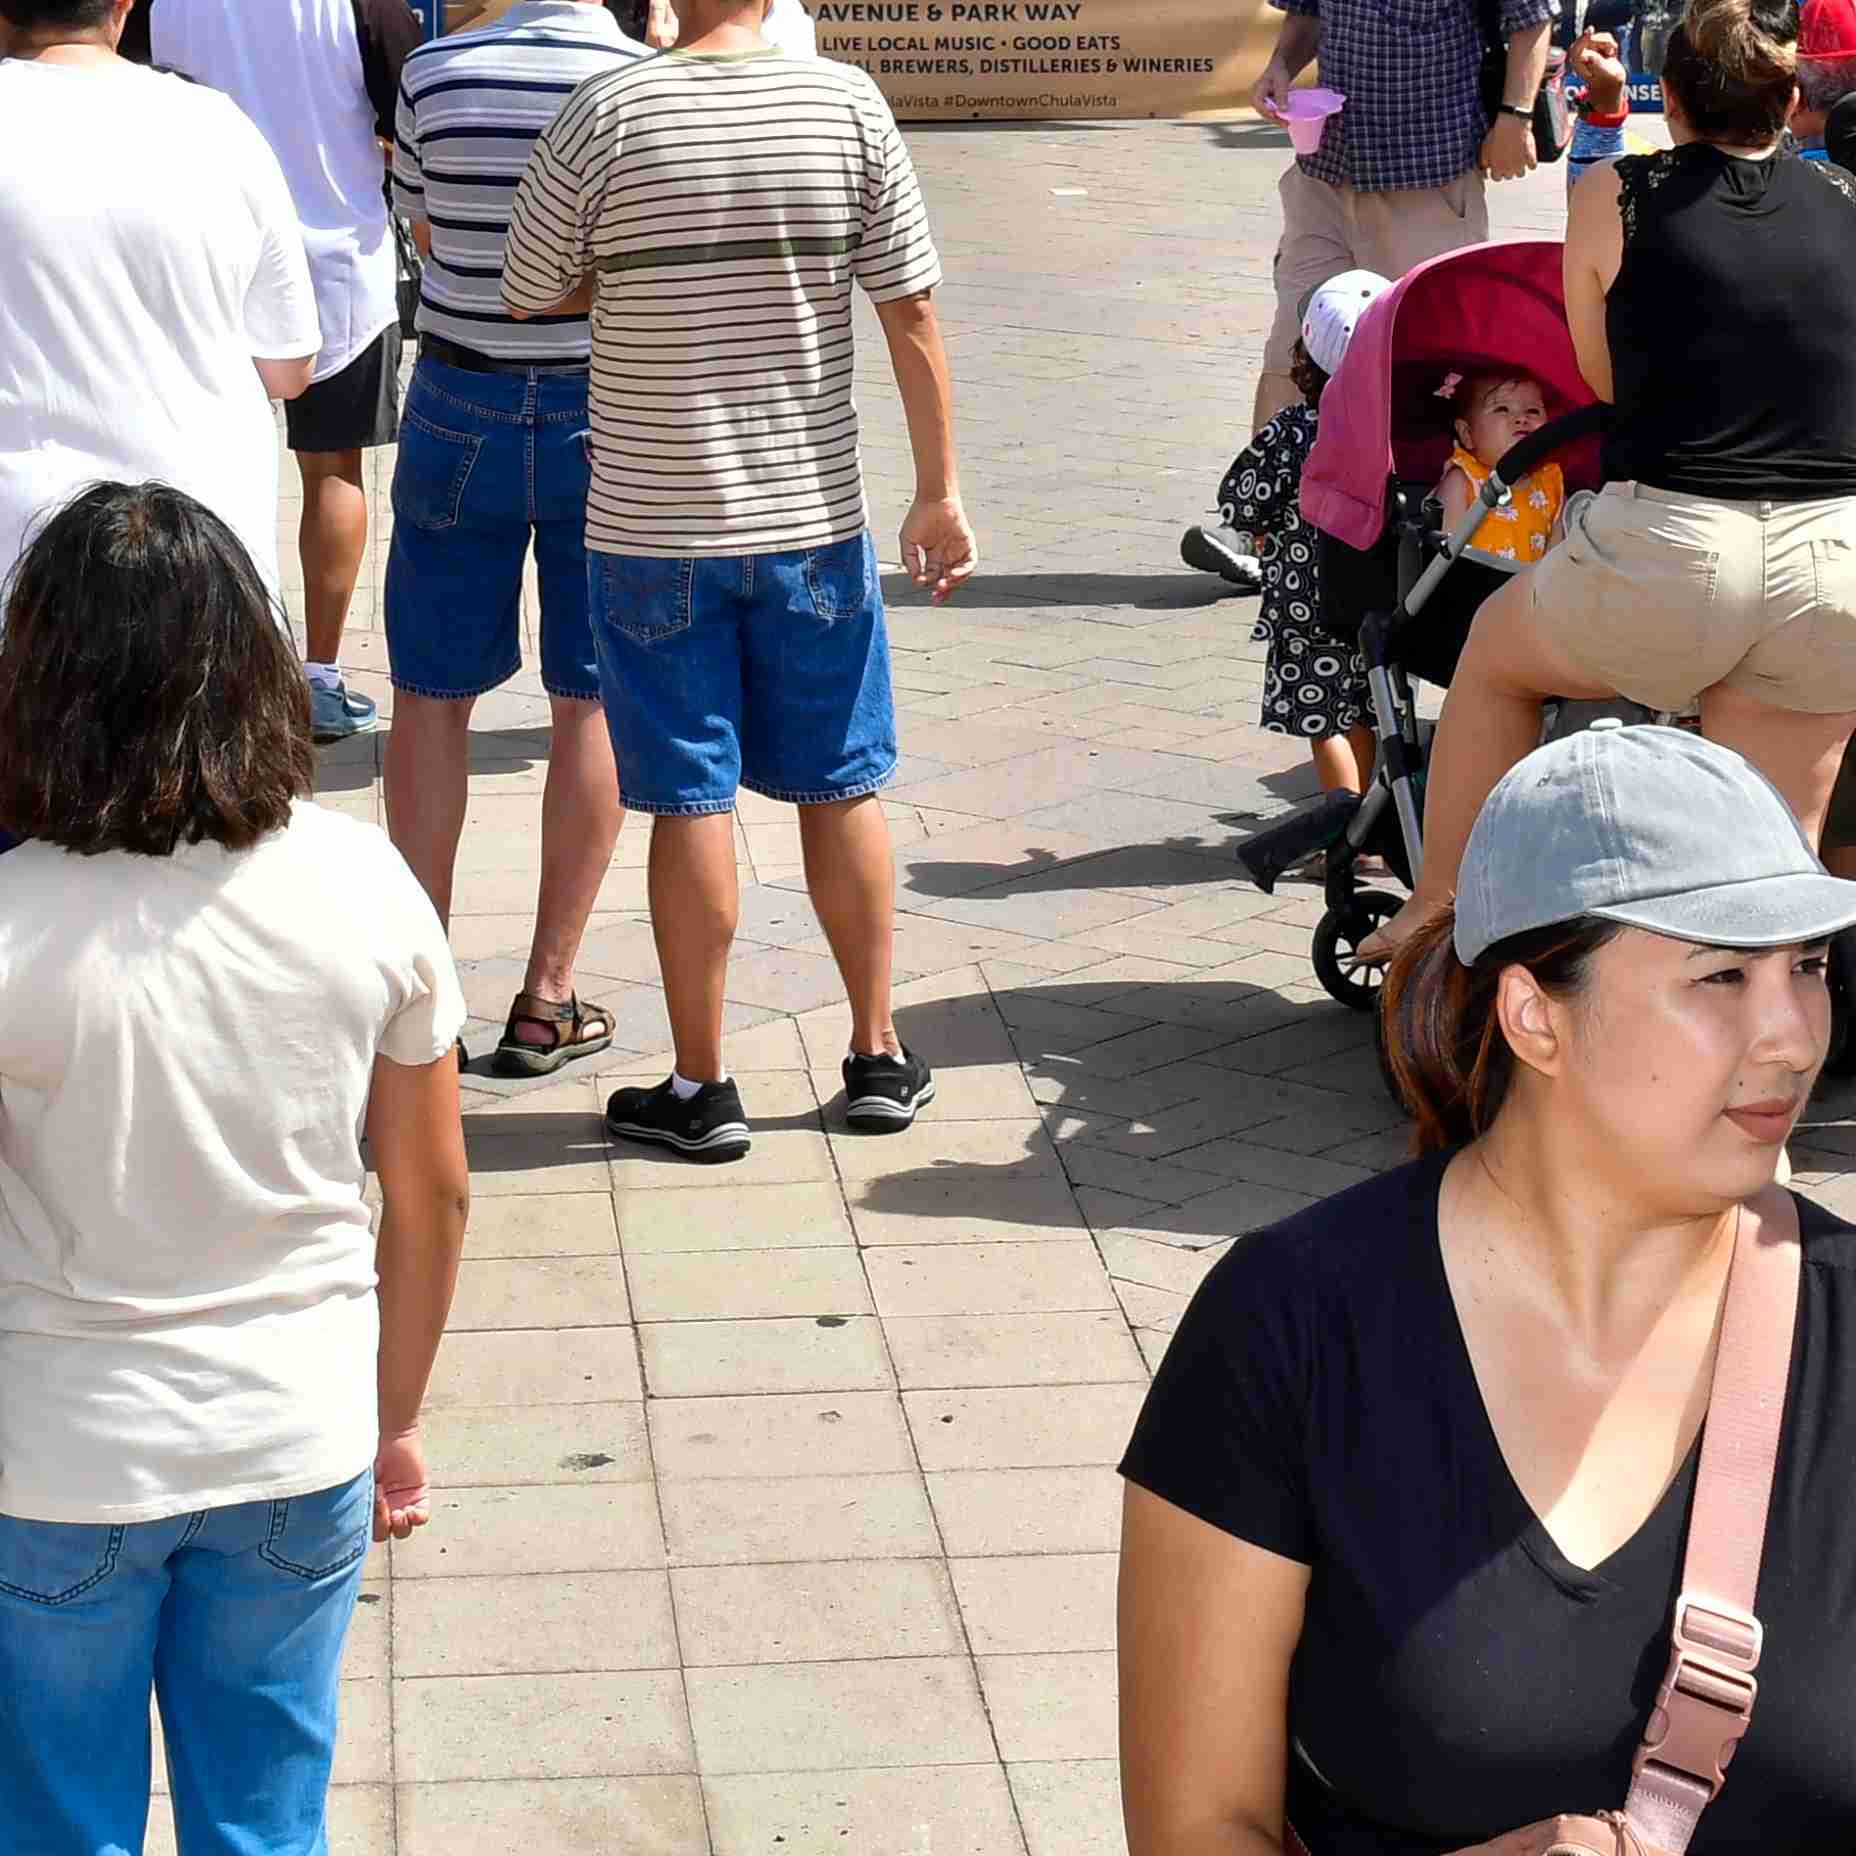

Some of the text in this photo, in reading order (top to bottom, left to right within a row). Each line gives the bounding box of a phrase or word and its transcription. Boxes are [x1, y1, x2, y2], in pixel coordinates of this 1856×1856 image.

[817, 4, 920, 22] AVENUE
[927, 3, 942, 22] &
[952, 4, 1017, 21] PARK
[1025, 3, 1082, 21] WAY
[822, 35, 1121, 52] LIVE LOCAL MUSIC GOOD EATS
[880, 58, 975, 76] BREWERS,
[980, 58, 1101, 74] DISTILLERIES
[1106, 58, 1117, 73] &
[1122, 58, 1214, 73] WINERIES
[943, 93, 1118, 110] #DowntownChulaVista
